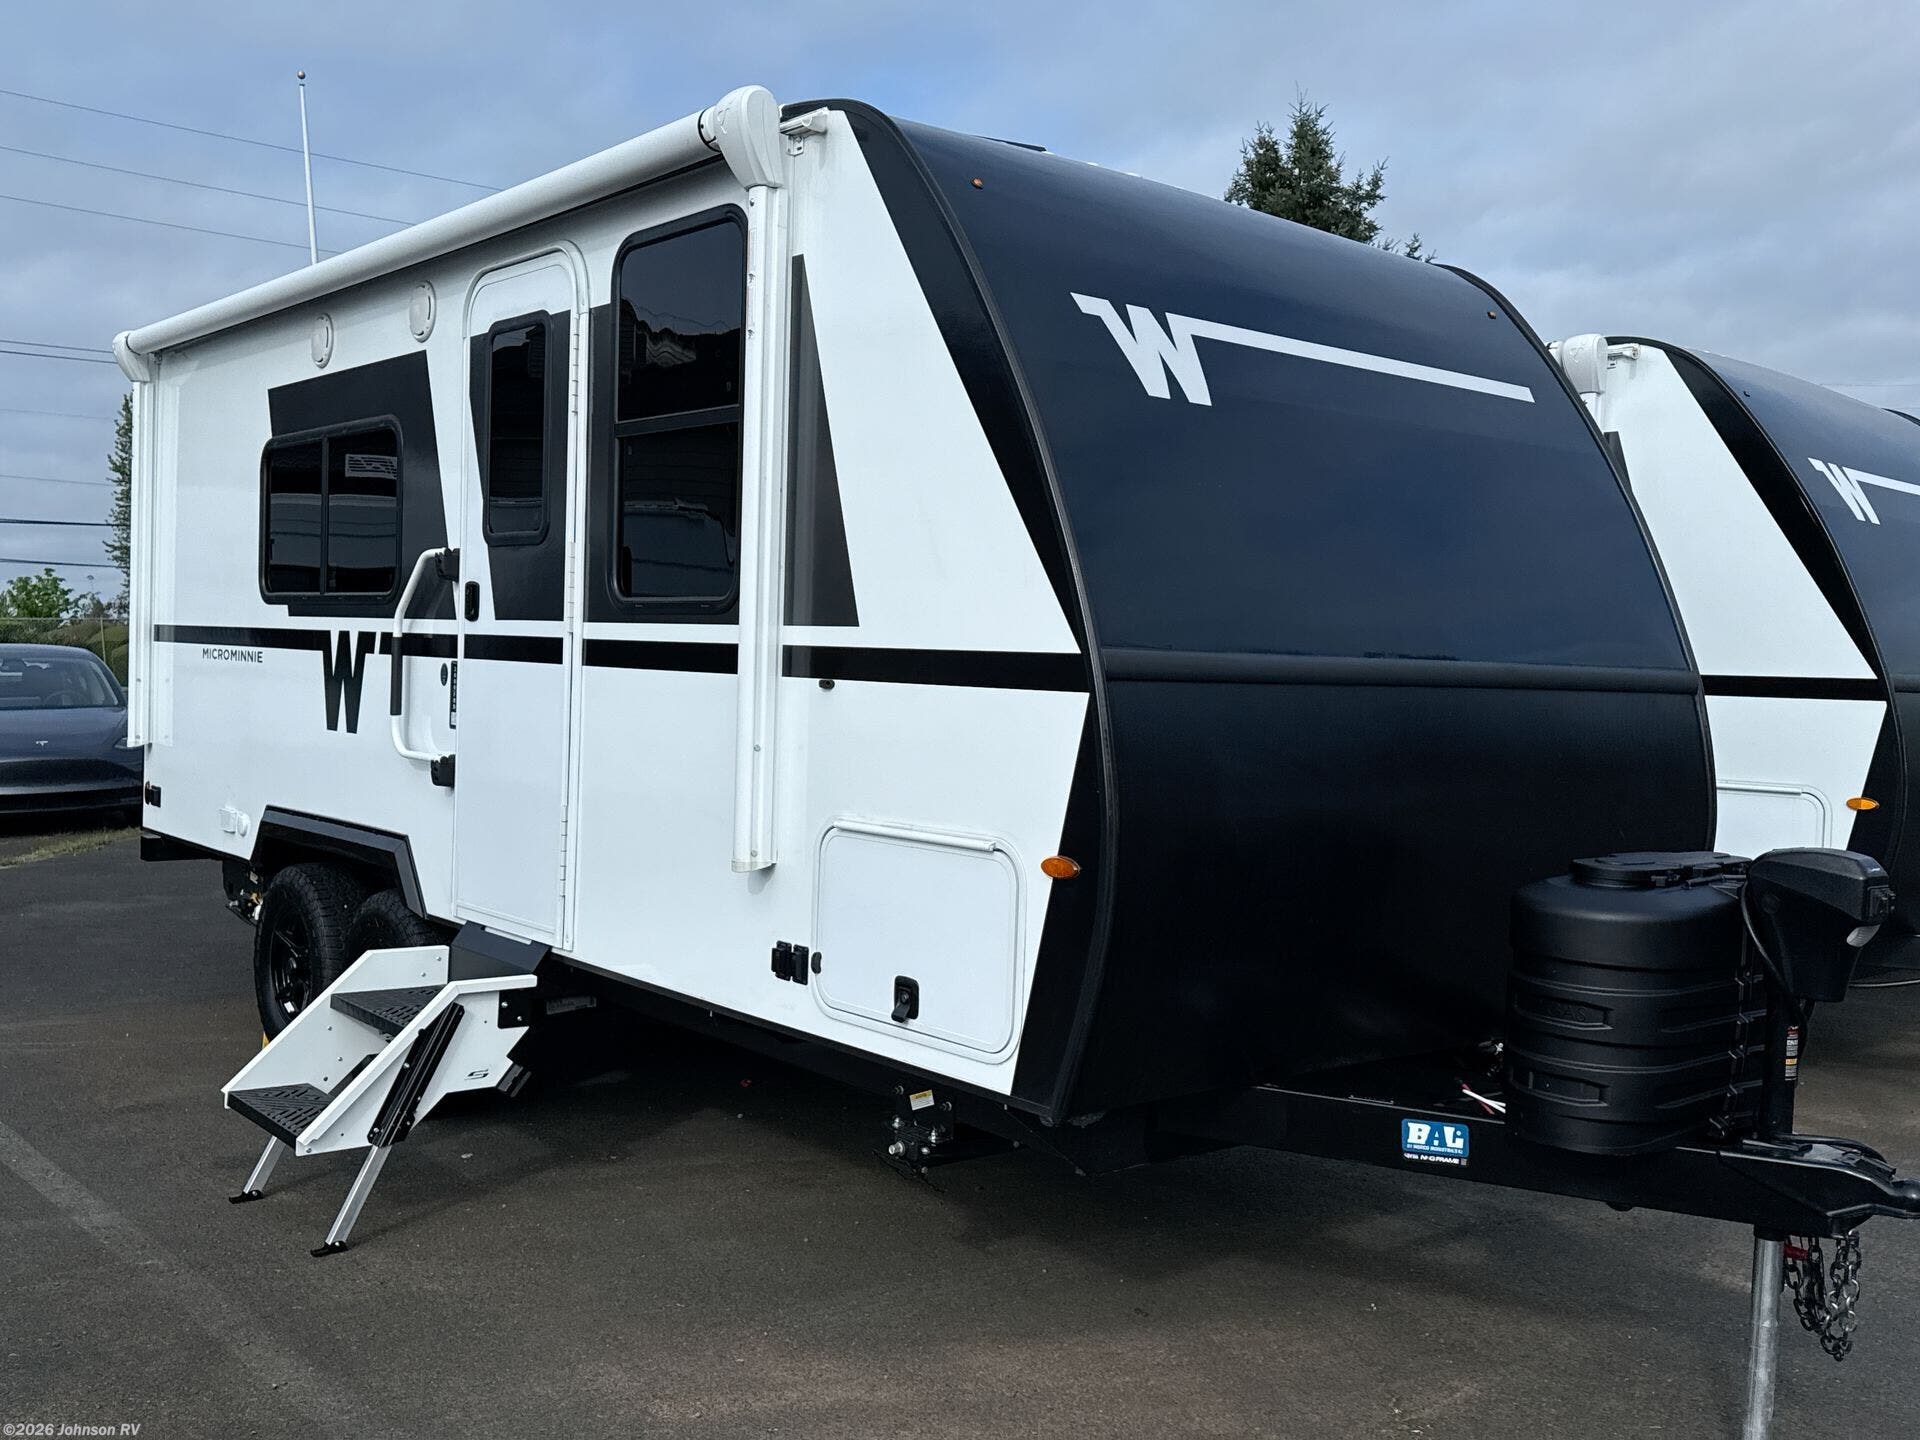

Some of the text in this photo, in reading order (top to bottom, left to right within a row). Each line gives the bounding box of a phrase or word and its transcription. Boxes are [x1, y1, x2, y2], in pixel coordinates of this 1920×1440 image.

[202, 648, 263, 663] MICROMINNIE
[322, 629, 376, 734] W
[1407, 1122, 1464, 1149] BAL
